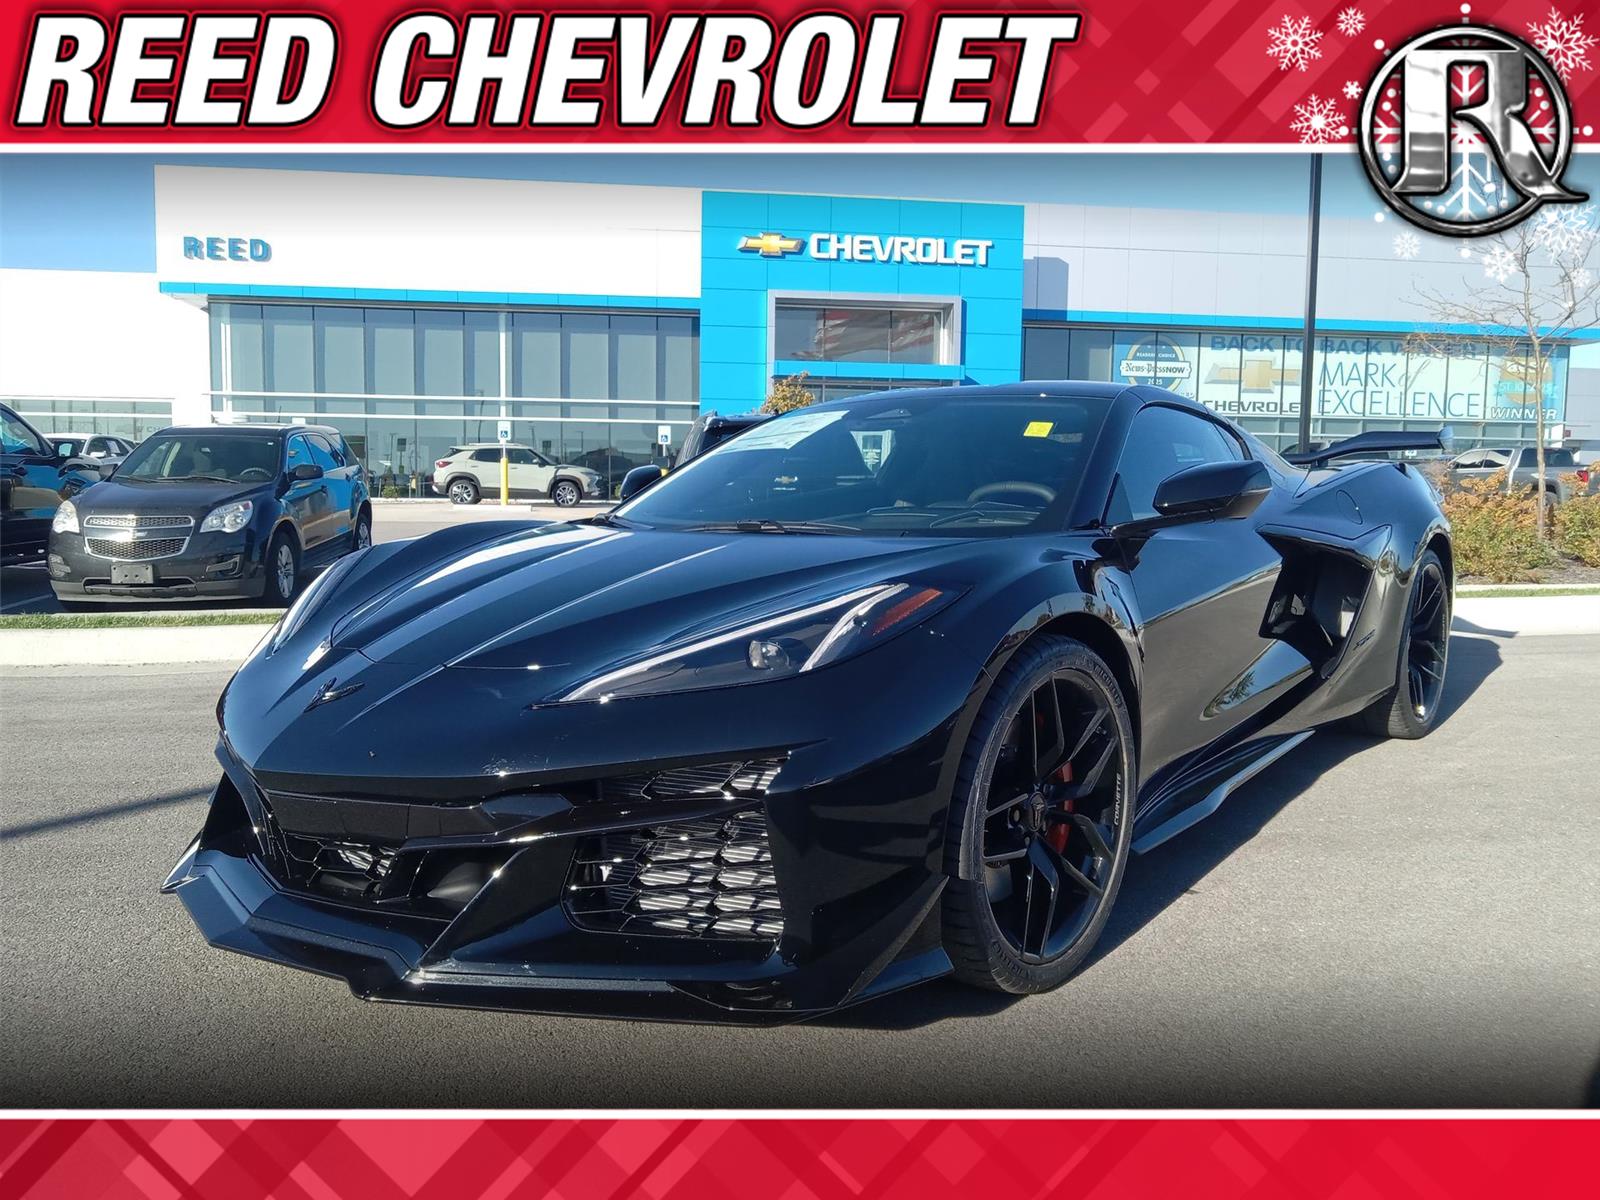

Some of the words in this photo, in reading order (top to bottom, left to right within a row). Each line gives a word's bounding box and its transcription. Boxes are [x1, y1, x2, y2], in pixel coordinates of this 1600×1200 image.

[183, 236, 272, 262] REED
[809, 232, 993, 266] CHEVROLET
[1211, 336, 1275, 353] BACK
[1320, 338, 1382, 355] BACK
[1318, 361, 1397, 388] MARK
[1203, 400, 1302, 413] CHEVROLE
[1318, 389, 1480, 417] EXCELLENCE
[1114, 772, 1122, 826] CORVETTE
